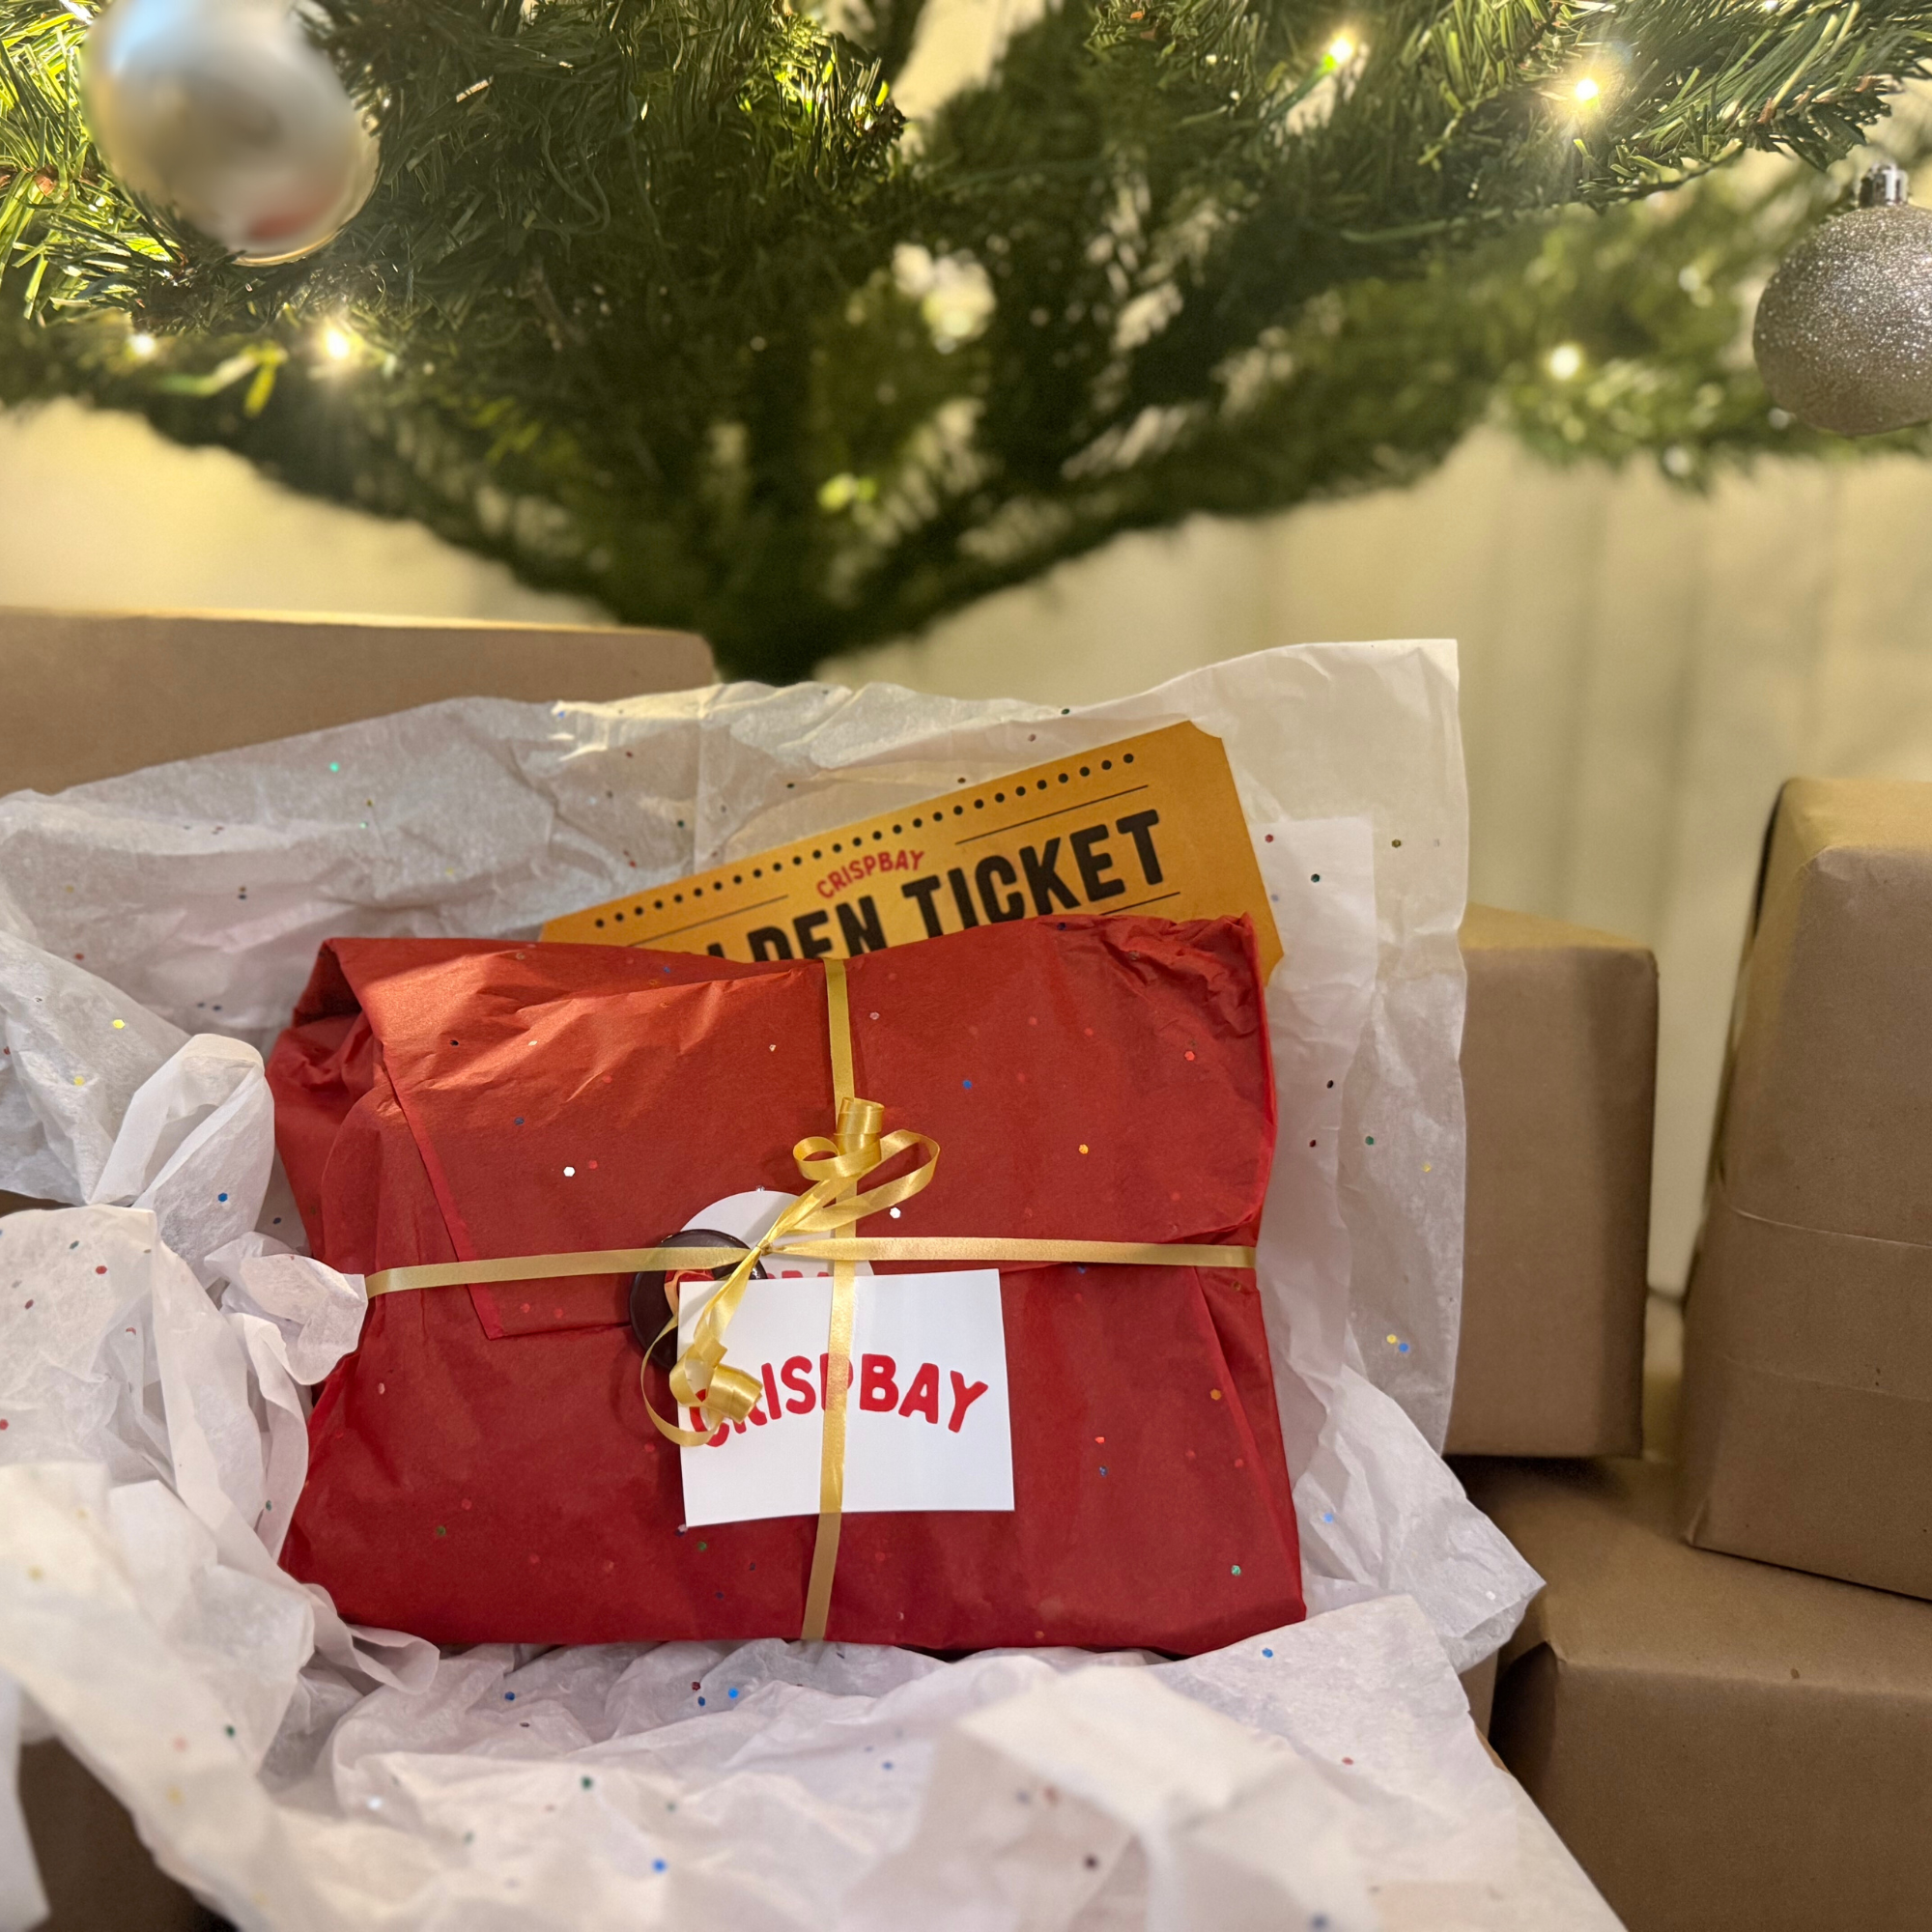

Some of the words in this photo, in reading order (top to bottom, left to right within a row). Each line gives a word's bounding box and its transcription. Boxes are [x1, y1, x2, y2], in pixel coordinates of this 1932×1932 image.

[707, 895, 888, 962] EN
[900, 809, 1164, 939] TICKET
[816, 849, 924, 898] CRISPBAY
